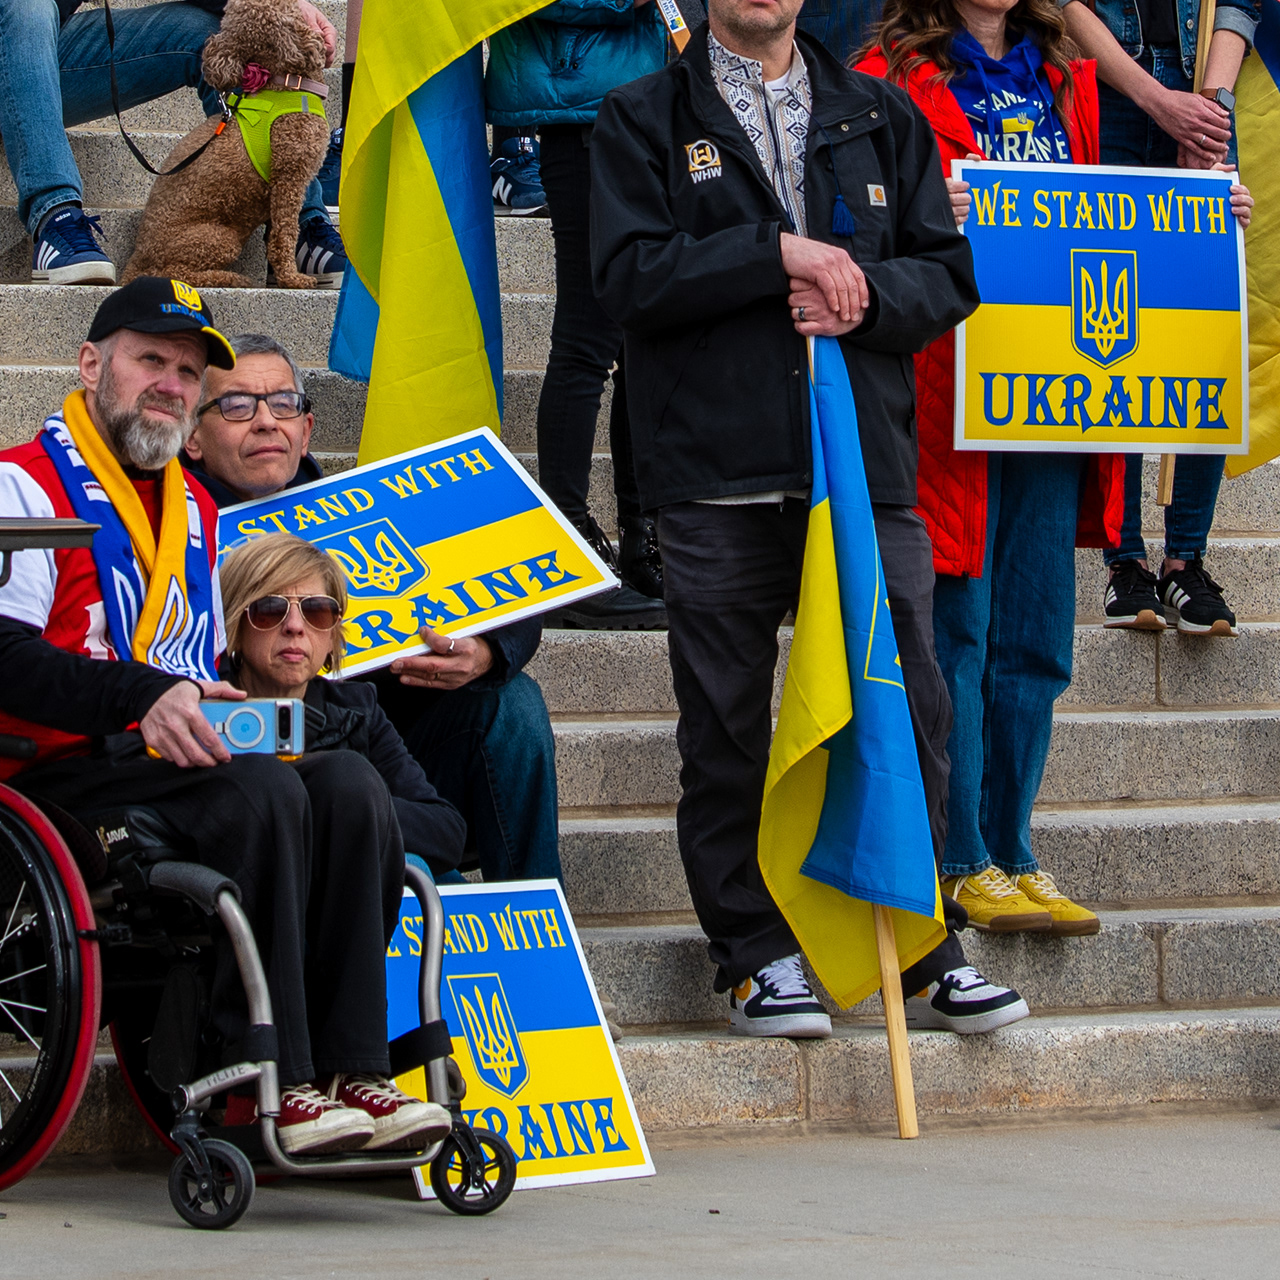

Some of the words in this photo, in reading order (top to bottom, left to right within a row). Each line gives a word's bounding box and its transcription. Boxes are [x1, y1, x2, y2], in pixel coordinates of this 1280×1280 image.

[691, 166, 722, 184] WHW
[971, 179, 1022, 227] WE
[1033, 189, 1137, 231] STAND
[1147, 186, 1228, 234] WITH
[979, 372, 1230, 434] UKRAINE
[379, 448, 494, 499] WITH
[106, 826, 129, 844] JAVA
[489, 901, 567, 951] WITH
